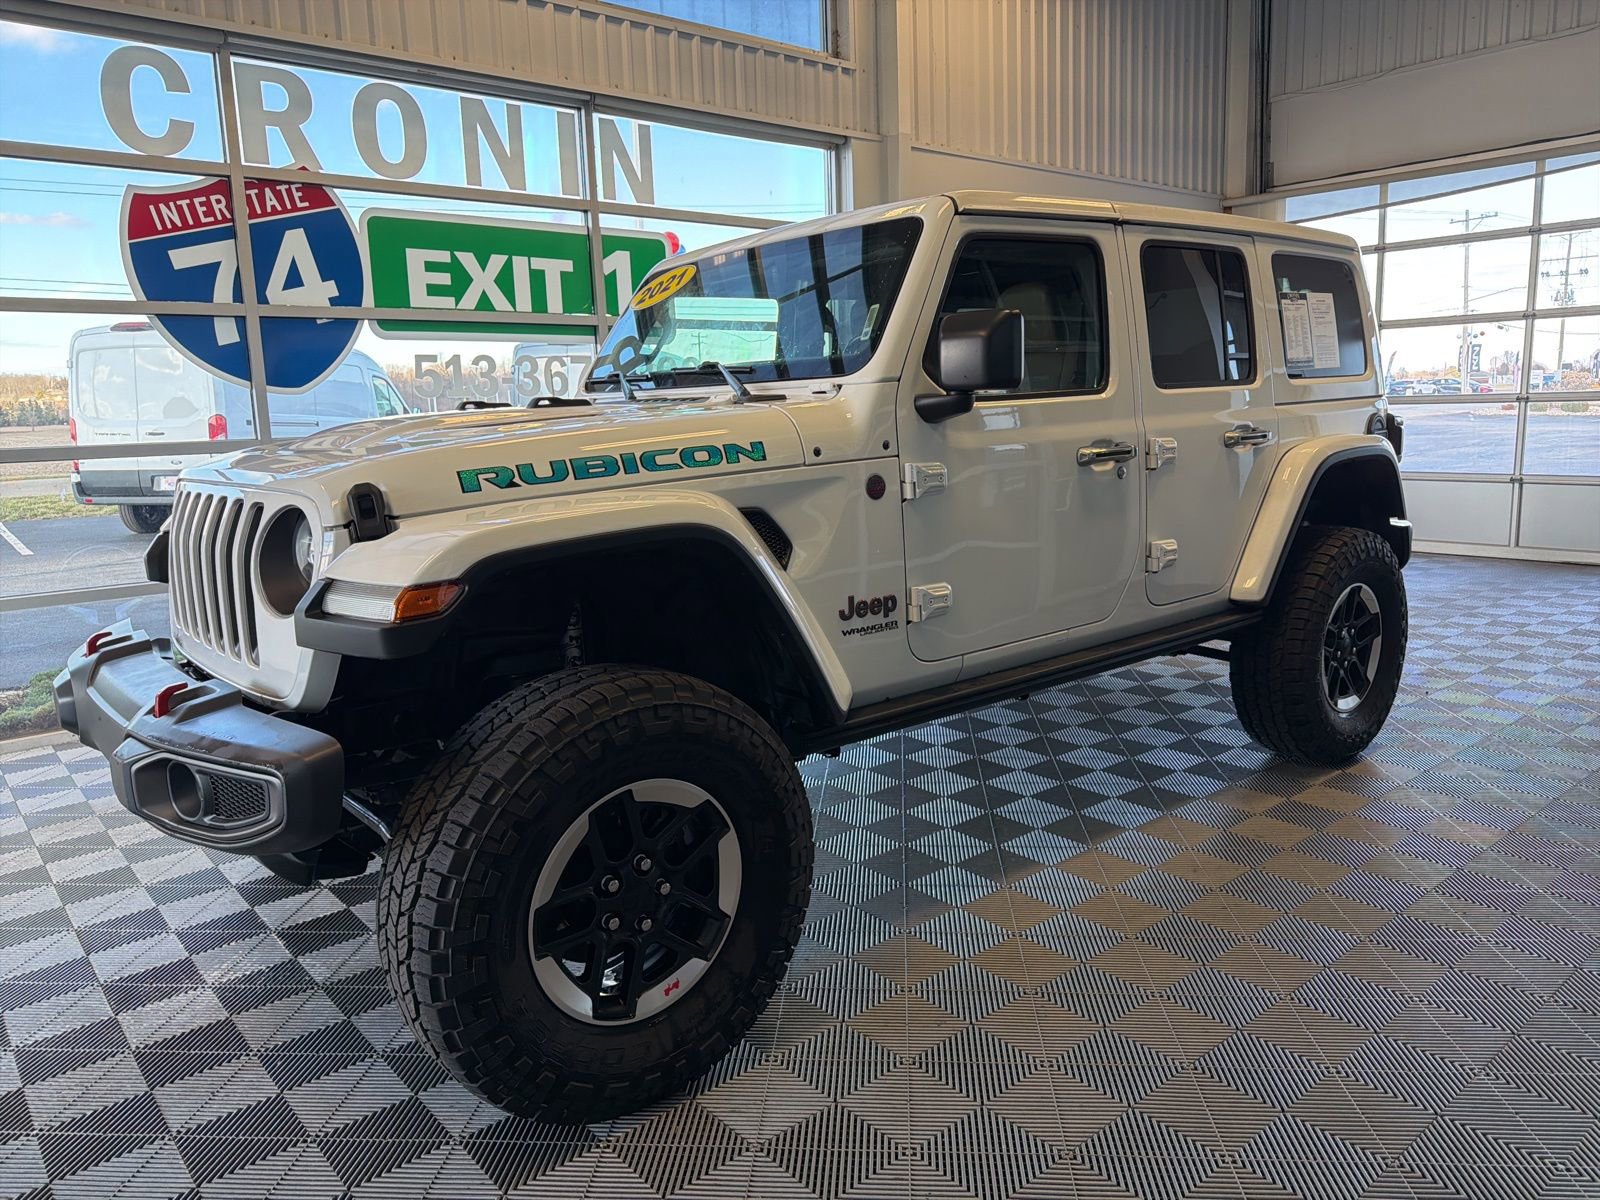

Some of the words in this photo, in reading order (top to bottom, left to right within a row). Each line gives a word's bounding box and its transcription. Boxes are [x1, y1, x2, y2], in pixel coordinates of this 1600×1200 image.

[100, 45, 655, 205] CRONIN
[149, 183, 309, 231] INTERTATE
[167, 228, 339, 347] 74
[405, 247, 573, 314] EXIT
[636, 271, 689, 306] 2021
[456, 441, 767, 493] RUBICON
[839, 594, 898, 621] Jeep
[842, 620, 898, 637] WRANGLER
